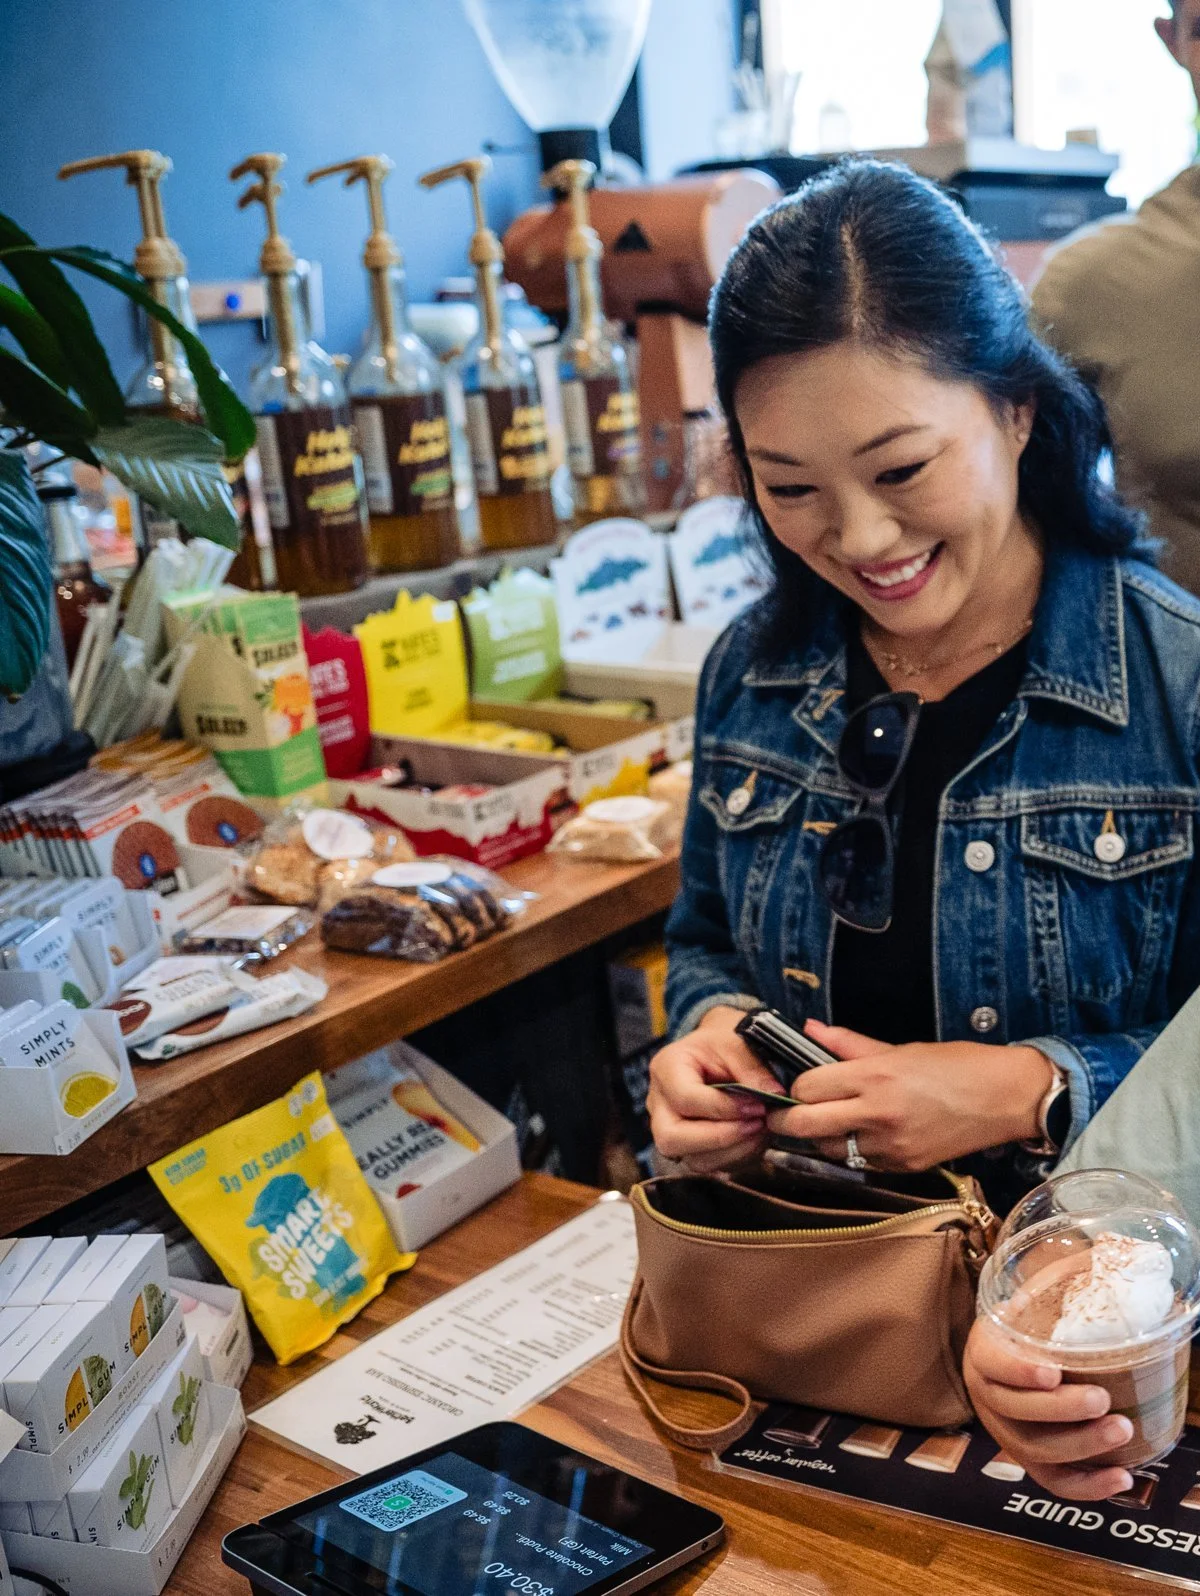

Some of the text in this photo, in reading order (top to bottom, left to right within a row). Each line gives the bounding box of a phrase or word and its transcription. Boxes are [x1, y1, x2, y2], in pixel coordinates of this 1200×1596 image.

[34, 935, 65, 964] SIMPLY
[20, 1020, 67, 1055] SIMPLY
[34, 1037, 76, 1068] MINTS
[356, 1132, 405, 1173] EALLY
[241, 1159, 262, 1182] OF
[258, 1186, 332, 1273] SMART
[282, 1200, 355, 1300] SWEETS
[58, 1361, 117, 1434] SIMPLY GUM
[482, 1497, 513, 1517] $6.49
[501, 1488, 531, 1507] $0.25
[1003, 1494, 1105, 1532] GUIDE
[462, 1507, 493, 1526] $6.49
[511, 1532, 594, 1578] Chocolate Puddi...
[557, 1535, 614, 1567] Parfait (GF)
[608, 1542, 633, 1556] Milk
[482, 1559, 555, 1596] $30.40
